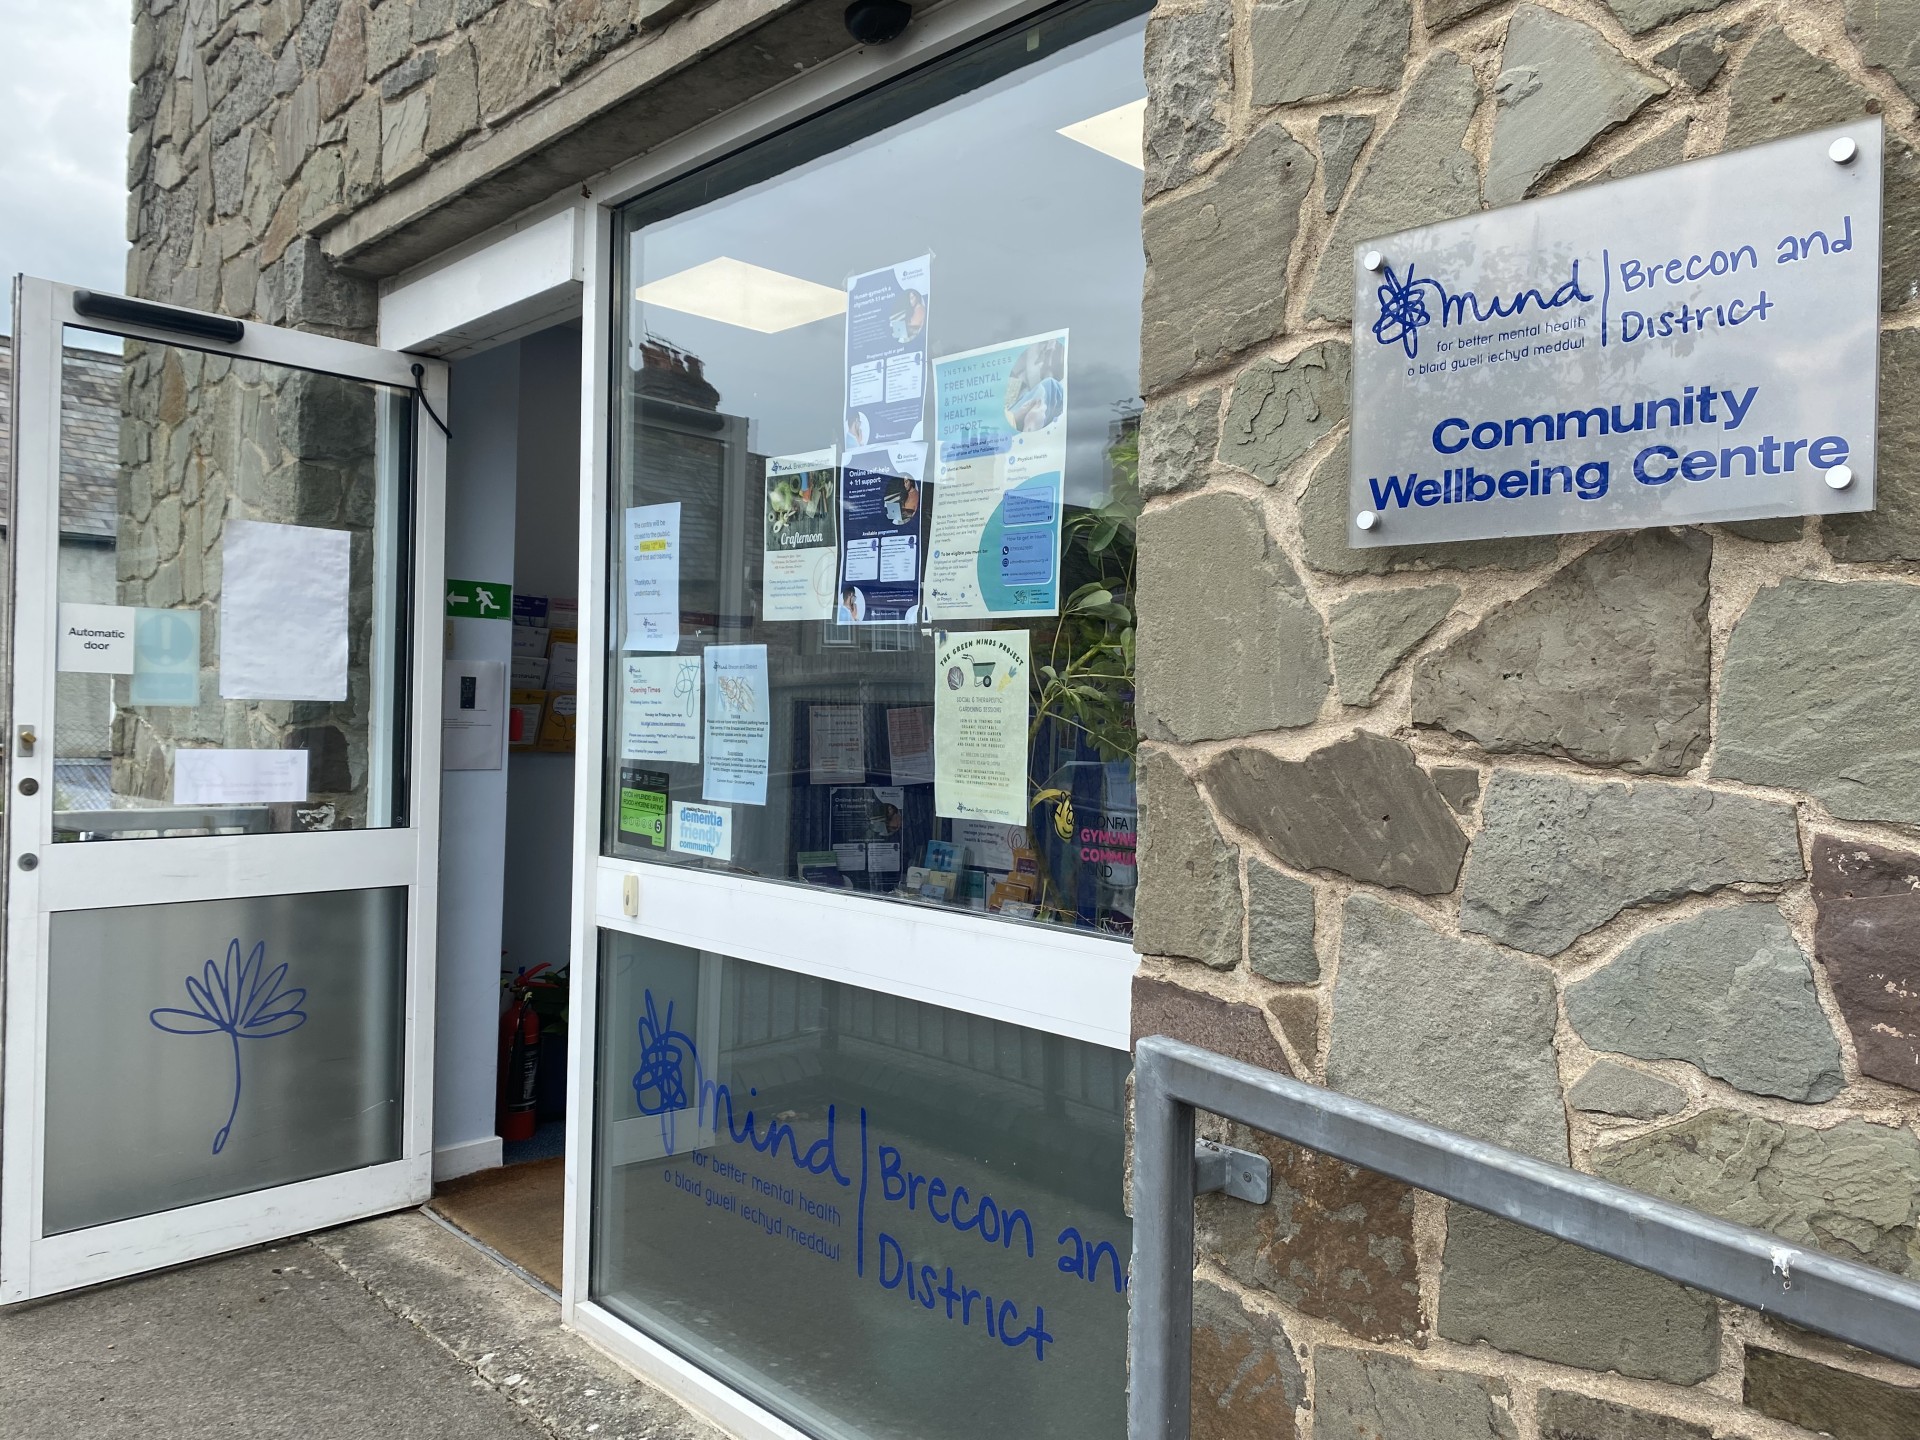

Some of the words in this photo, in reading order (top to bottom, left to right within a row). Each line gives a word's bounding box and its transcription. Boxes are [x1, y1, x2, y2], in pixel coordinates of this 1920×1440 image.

[1620, 244, 1757, 292] Brecon
[1777, 216, 1852, 263] and
[1441, 259, 1594, 328] mind
[1621, 290, 1773, 342] District
[1436, 336, 1453, 353] for
[1458, 332, 1494, 350] better
[1498, 323, 1542, 342] mental
[1545, 316, 1586, 337] health
[944, 364, 977, 377] INSTANT
[981, 356, 1012, 368] ACCESS
[1407, 366, 1415, 376] o
[1419, 358, 1447, 375] blaid
[1450, 352, 1483, 373] gwell
[1487, 345, 1529, 367] iechyd
[1533, 337, 1585, 355] meddwl
[944, 380, 965, 392] FREE
[966, 372, 1002, 387] MENTAL
[952, 388, 995, 405] PHYSICAL
[944, 407, 976, 421] HEALTH
[1432, 385, 1759, 454] Community
[943, 419, 983, 435] SUPPORT
[861, 478, 882, 486] support
[1369, 459, 1608, 510] Wellbeing
[1633, 434, 1850, 486] Centre
[781, 532, 823, 548] Crafternoon
[68, 627, 125, 639] Automatic
[83, 640, 110, 651] door
[940, 653, 951, 667] THE
[953, 640, 973, 655] GREEN
[976, 638, 996, 646] MINDS
[998, 642, 1024, 666] PROJECT
[630, 686, 647, 695] Opening
[623, 798, 634, 806] FOOD
[634, 801, 650, 809] HYGIENE
[650, 803, 664, 811] RATING
[656, 821, 661, 832] 5
[680, 807, 723, 827] dementia
[680, 822, 723, 848] friendly
[680, 840, 715, 855] community
[699, 1078, 850, 1186] mind
[692, 1147, 708, 1168] for
[712, 1158, 748, 1185] better
[751, 1174, 794, 1204] mental
[800, 1190, 841, 1228] health
[664, 1170, 671, 1183] o
[675, 1169, 701, 1197] blaid
[705, 1185, 736, 1213] gwell
[741, 1199, 782, 1237] iechyd
[786, 1222, 840, 1262] meddwl
[879, 1146, 1034, 1257] Brecon
[1057, 1228, 1129, 1293] an
[878, 1232, 1054, 1361] District
